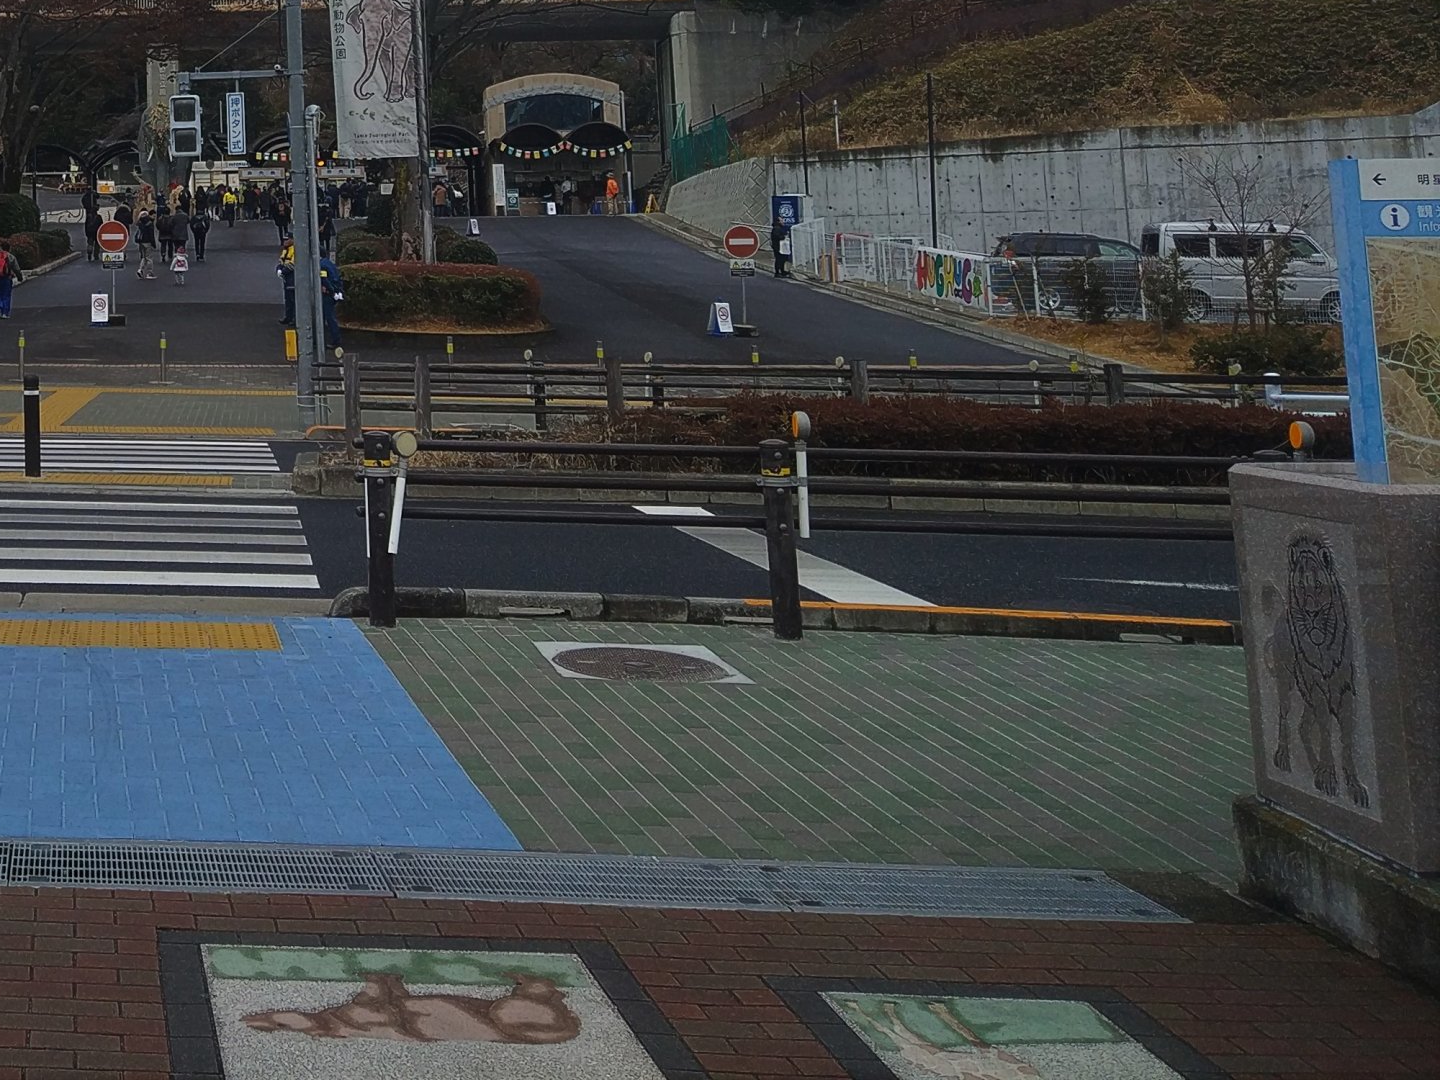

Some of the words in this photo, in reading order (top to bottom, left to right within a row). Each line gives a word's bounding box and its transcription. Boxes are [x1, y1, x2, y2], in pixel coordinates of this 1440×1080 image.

[230, 97, 242, 150] 押ボタン式
